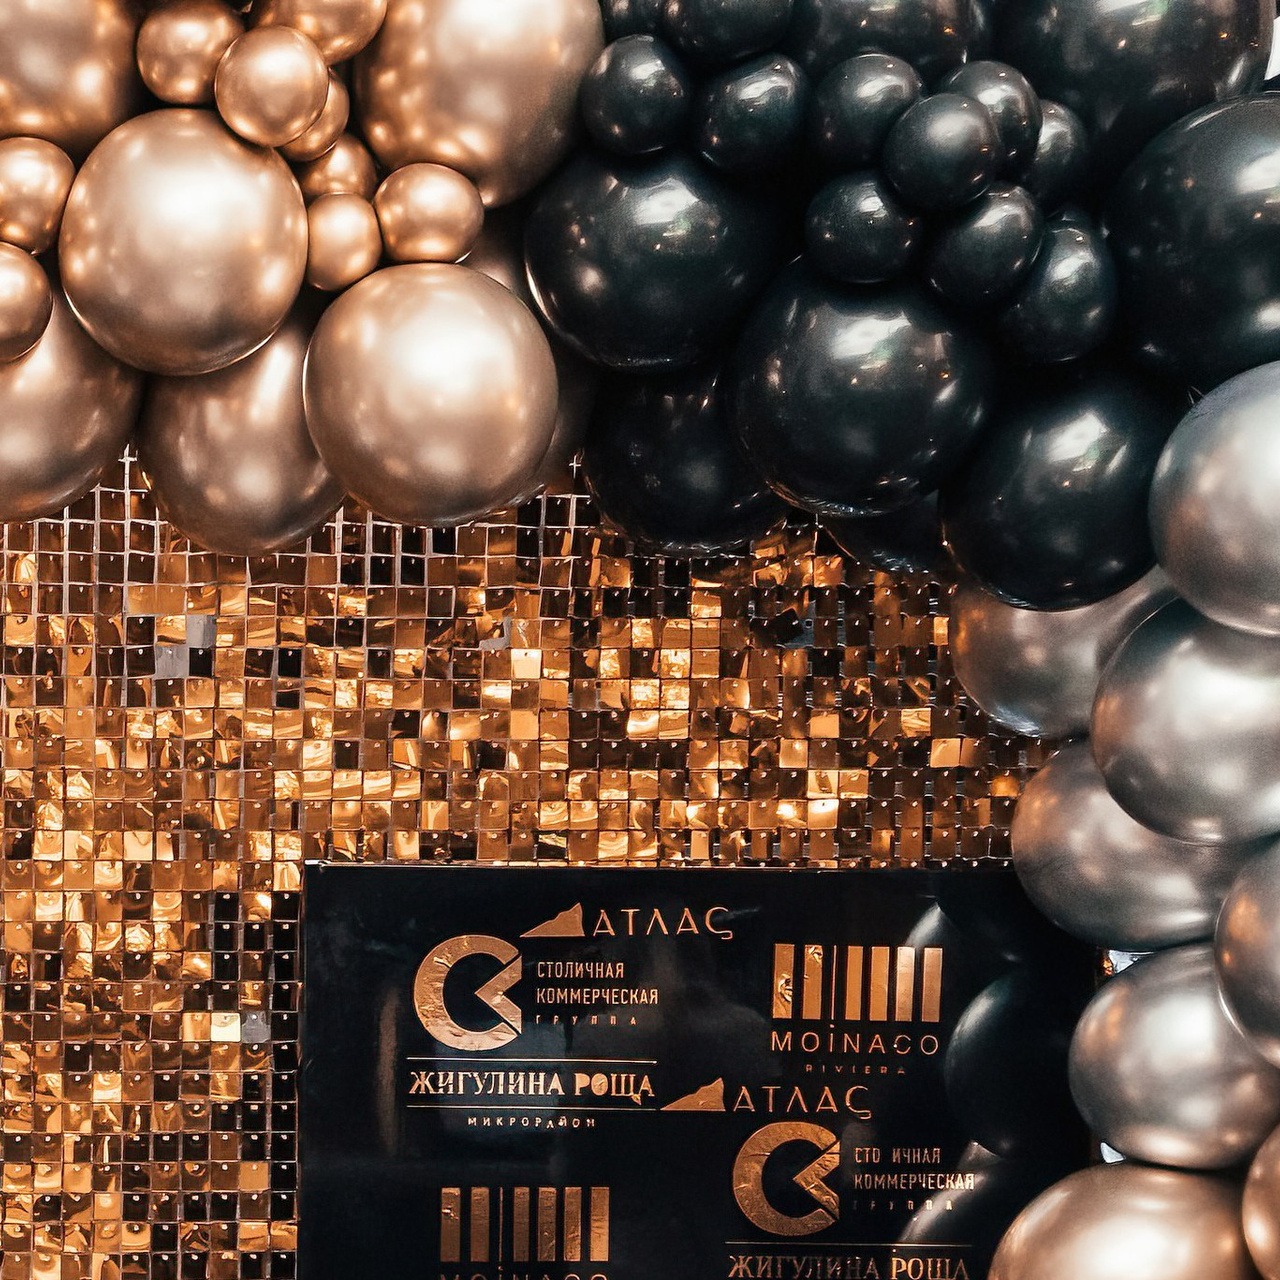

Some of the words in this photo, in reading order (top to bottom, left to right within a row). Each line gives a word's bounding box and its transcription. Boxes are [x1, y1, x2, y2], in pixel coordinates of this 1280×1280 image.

[536, 961, 625, 979] СТОЛИЧНАЯ
[535, 987, 660, 1005] КОММЕРЧЕСКАЯ
[534, 1013, 638, 1025] ГРУППА
[805, 1063, 907, 1075] RIVIERA
[407, 1070, 566, 1096] ЖИГУЛИНА
[573, 1071, 657, 1106] РОЩА
[467, 1116, 597, 1129] МИКРОРАЙОН
[853, 1173, 976, 1190] КОММЕРЧЕСКАЯ
[726, 1254, 880, 1280] ЖИГУЛИНА
